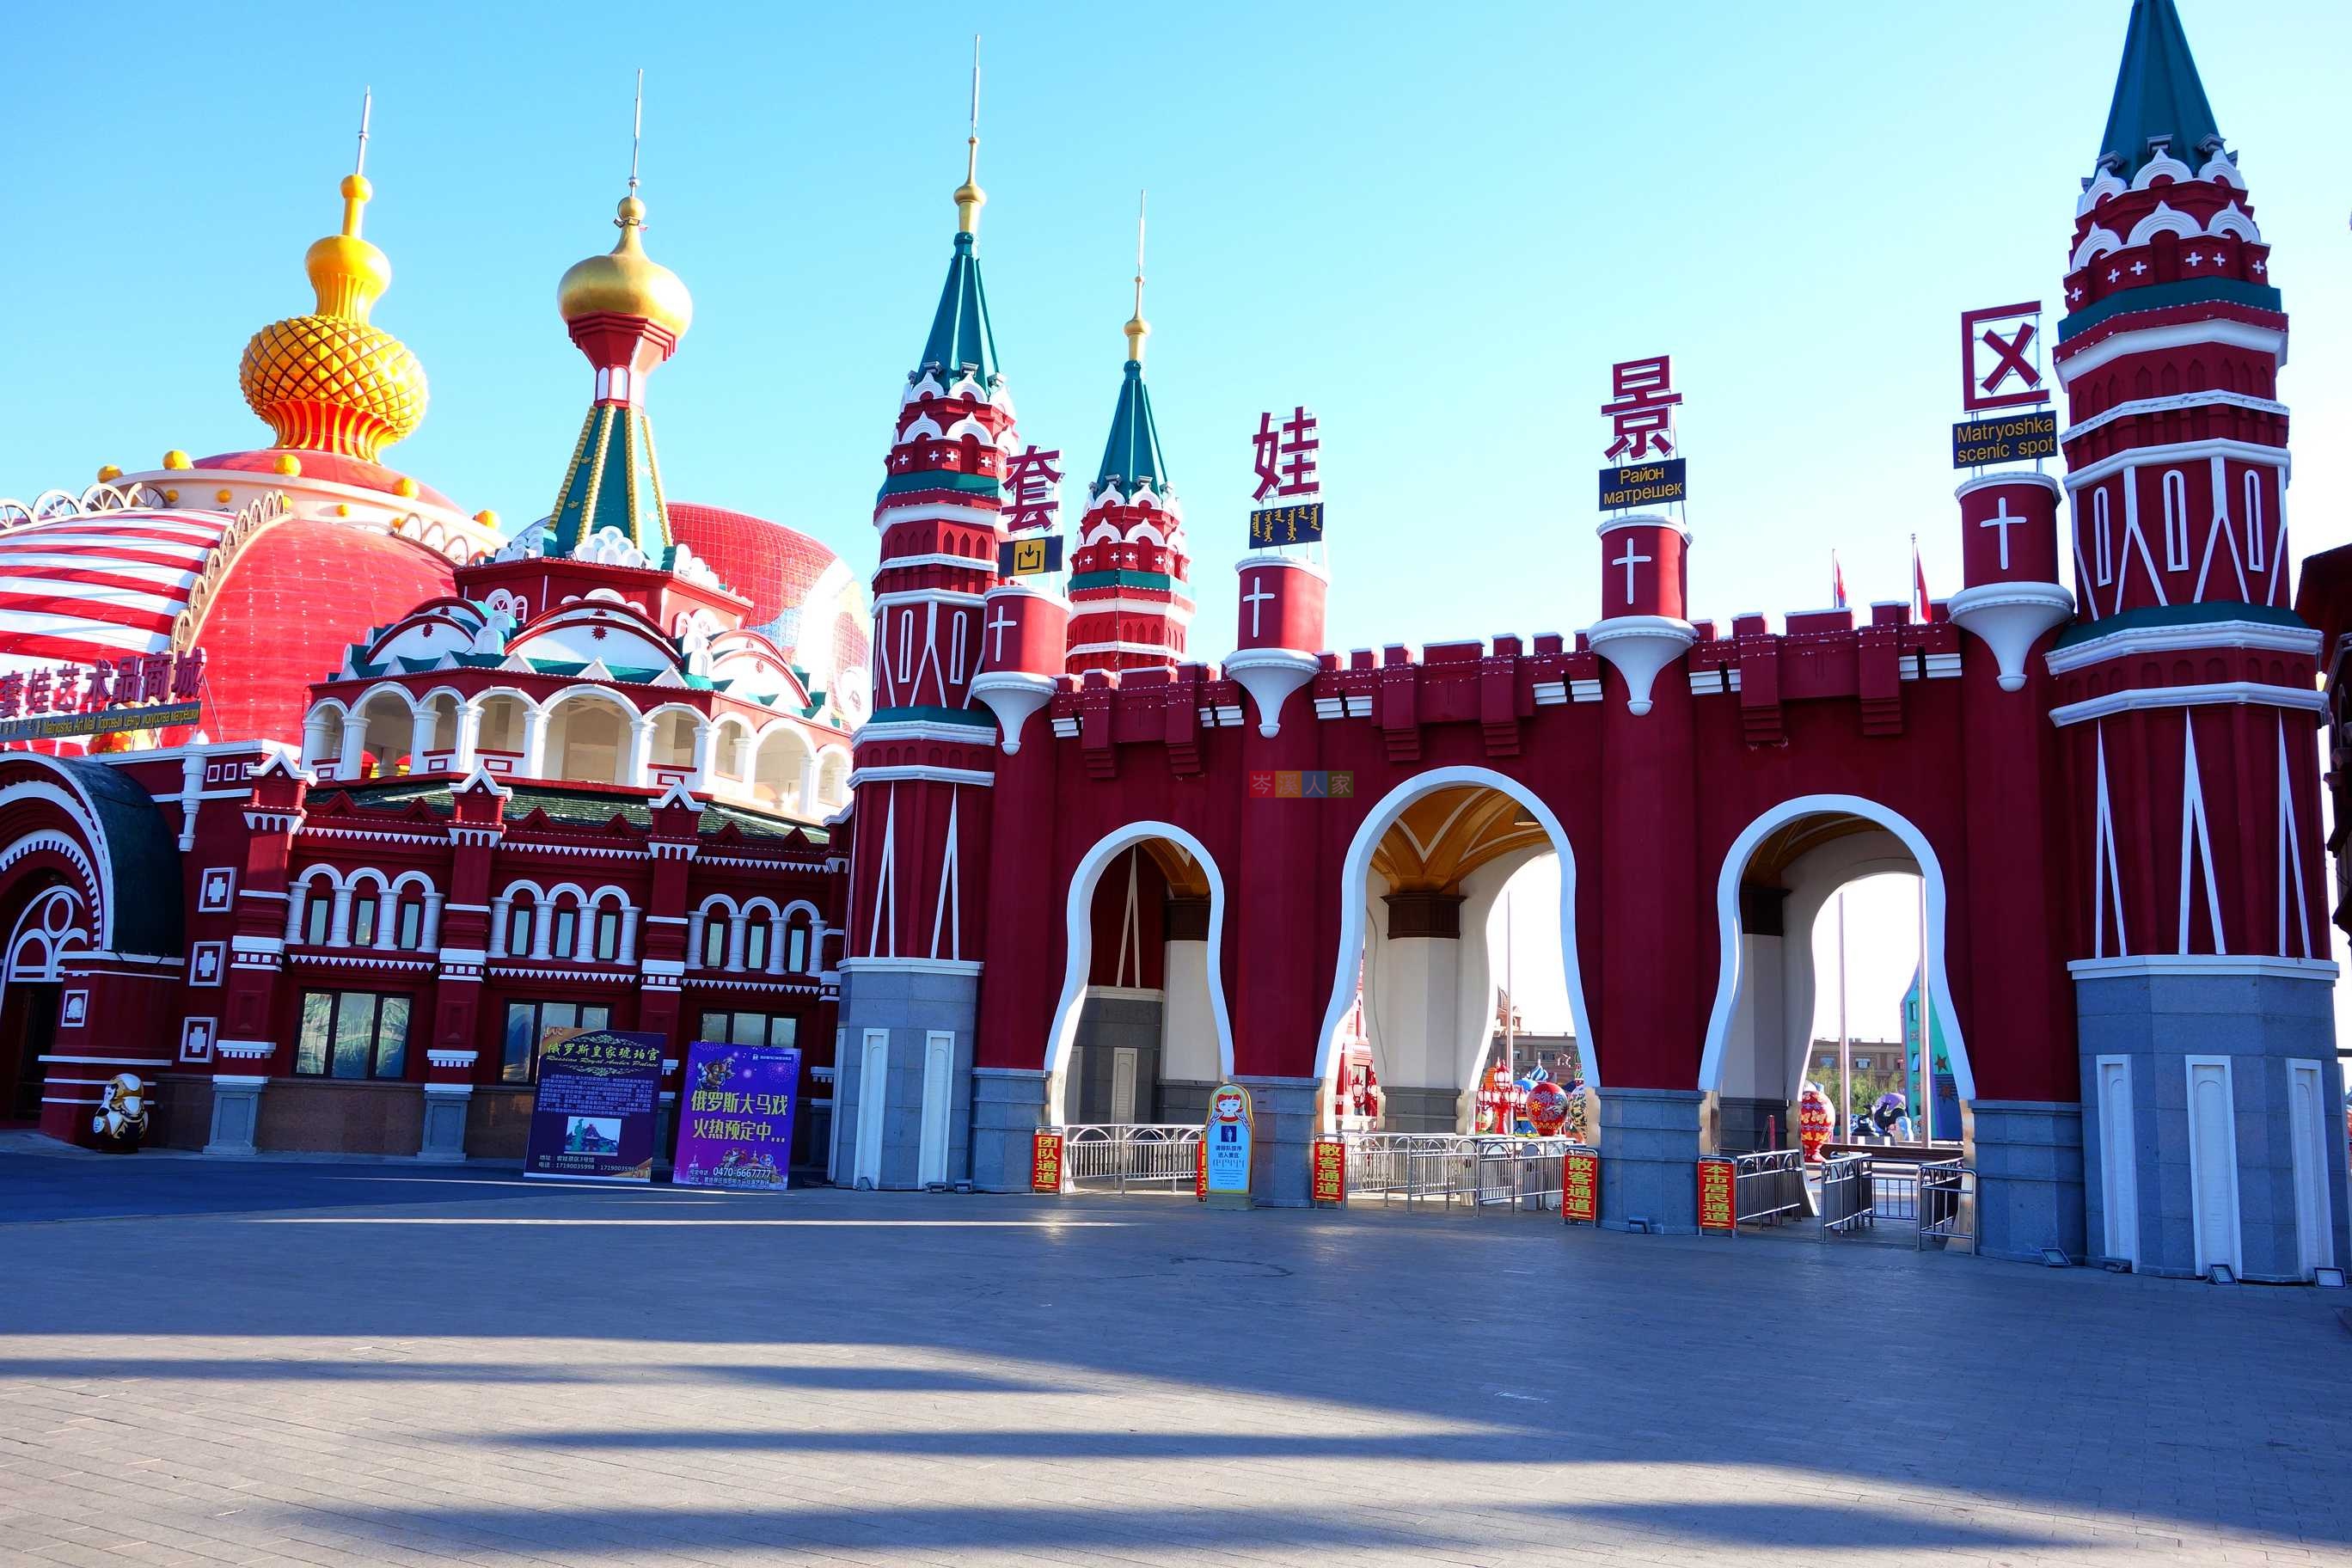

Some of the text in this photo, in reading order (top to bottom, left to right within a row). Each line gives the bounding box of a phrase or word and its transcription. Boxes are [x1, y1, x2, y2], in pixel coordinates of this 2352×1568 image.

[1962, 301, 2050, 413] 区
[1602, 355, 1682, 461] 景
[1957, 417, 2054, 443] Matryoshka
[1252, 407, 1320, 501] 娃
[1958, 436, 2054, 462] scenic spot
[1001, 445, 1065, 532] 套
[1620, 467, 1663, 485] Район
[548, 1043, 660, 1062] 俄罗斯皇家琥珀宫
[691, 1090, 787, 1116] 俄罗斯大马戏
[713, 1167, 771, 1178] 0470-6667777
[1036, 1136, 1058, 1184] 团队通道
[1316, 1143, 1342, 1195] 散客通道
[1567, 1157, 1594, 1213] 散客通道
[1703, 1165, 1730, 1222] 本市居民通道
